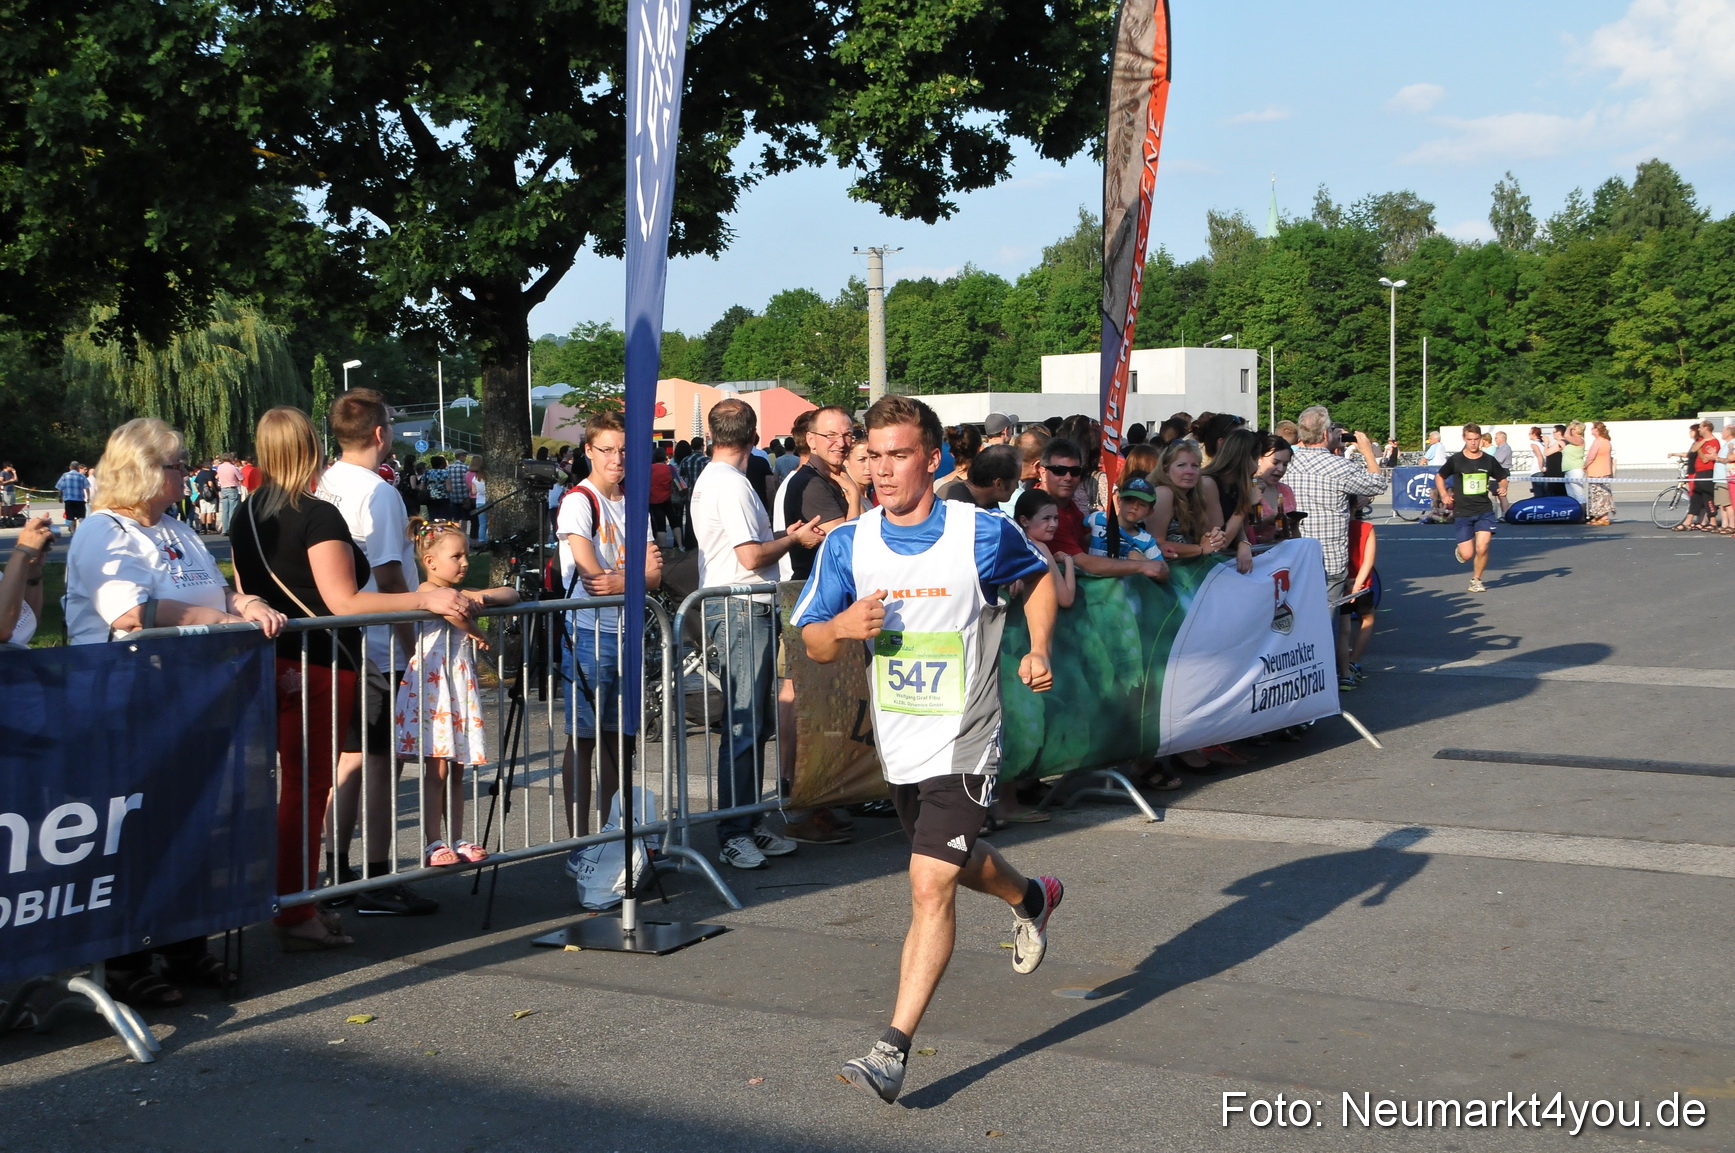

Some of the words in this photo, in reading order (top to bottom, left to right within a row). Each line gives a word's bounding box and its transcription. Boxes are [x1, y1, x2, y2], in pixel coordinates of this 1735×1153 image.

[1469, 480, 1480, 490] 81
[1526, 509, 1573, 520] Fischer
[892, 587, 952, 599] KLEBL
[1259, 642, 1315, 676] Neumarkter
[888, 659, 947, 693] 547
[1251, 664, 1325, 714] Lammsbräu
